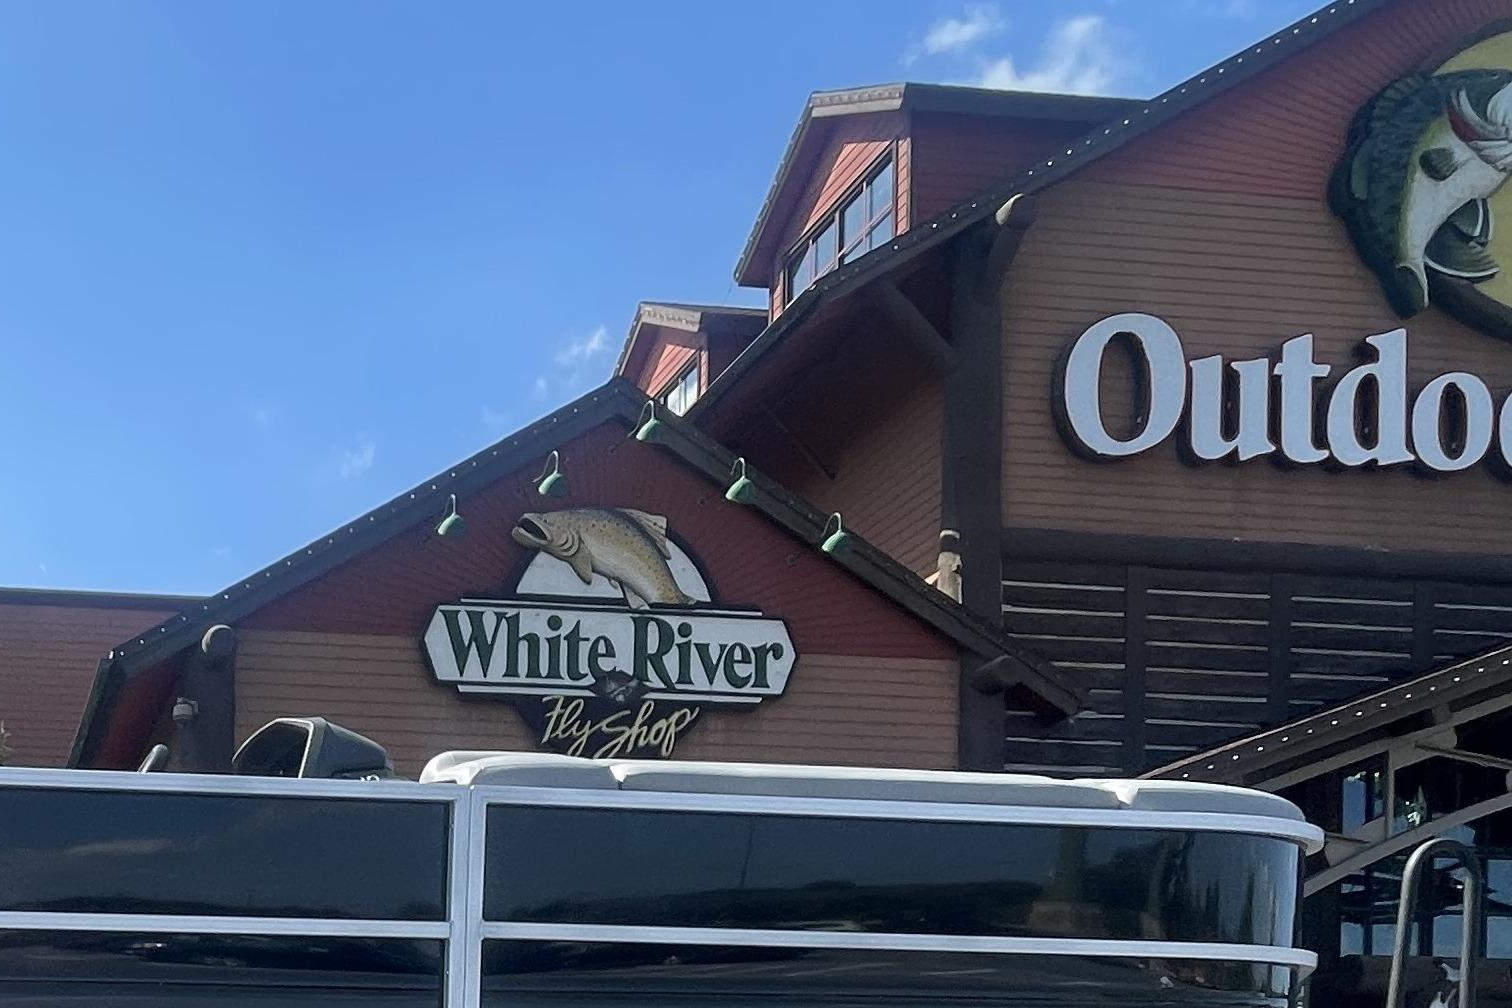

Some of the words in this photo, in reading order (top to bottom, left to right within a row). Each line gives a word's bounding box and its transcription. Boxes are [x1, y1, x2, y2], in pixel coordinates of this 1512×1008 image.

[1064, 312, 1512, 472] Outdo
[439, 608, 618, 682] White
[631, 614, 784, 691] River
[541, 695, 594, 757] Fly
[591, 699, 700, 759] Shop
